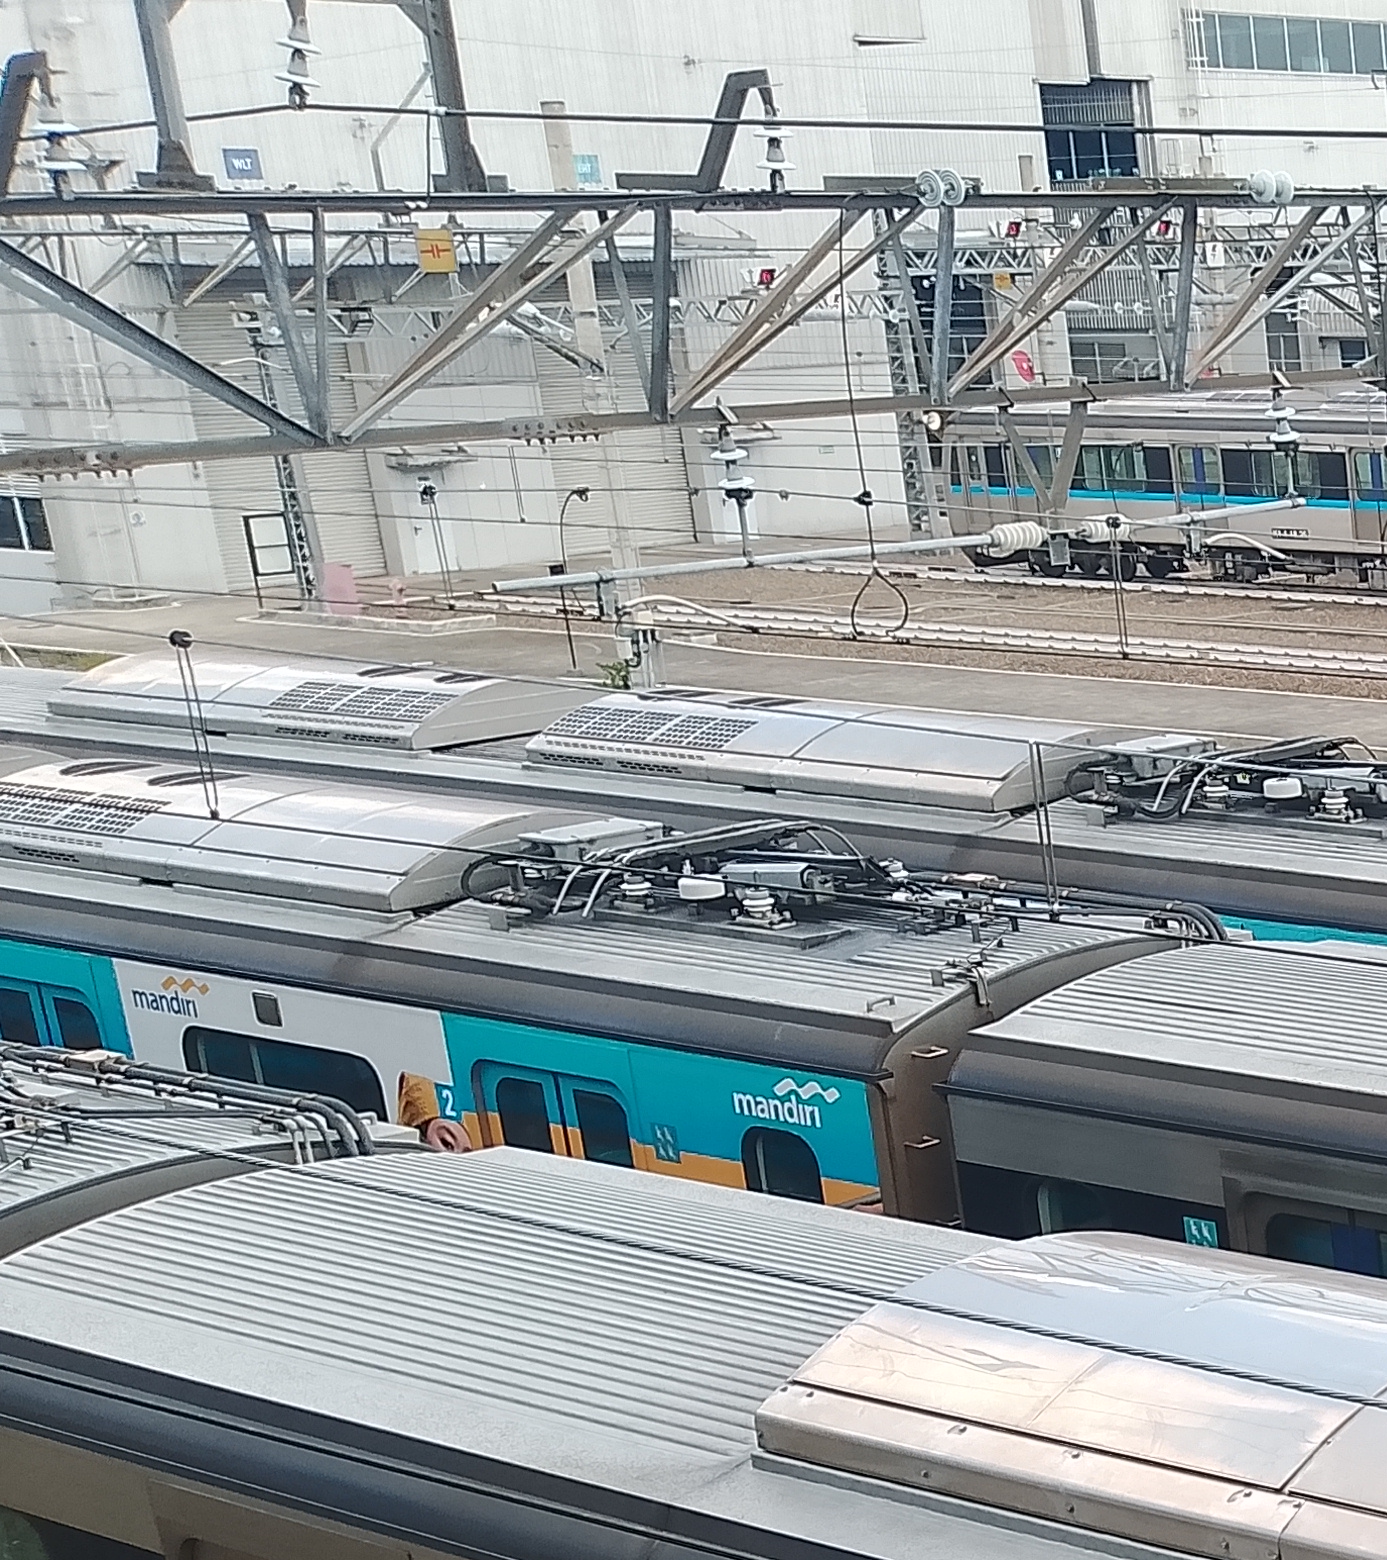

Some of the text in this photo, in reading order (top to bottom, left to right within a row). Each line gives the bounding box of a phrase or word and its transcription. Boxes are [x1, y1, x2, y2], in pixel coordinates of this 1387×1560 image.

[131, 989, 198, 1018] mandiri
[441, 1088, 457, 1117] 2
[733, 1092, 822, 1128] mandiri
